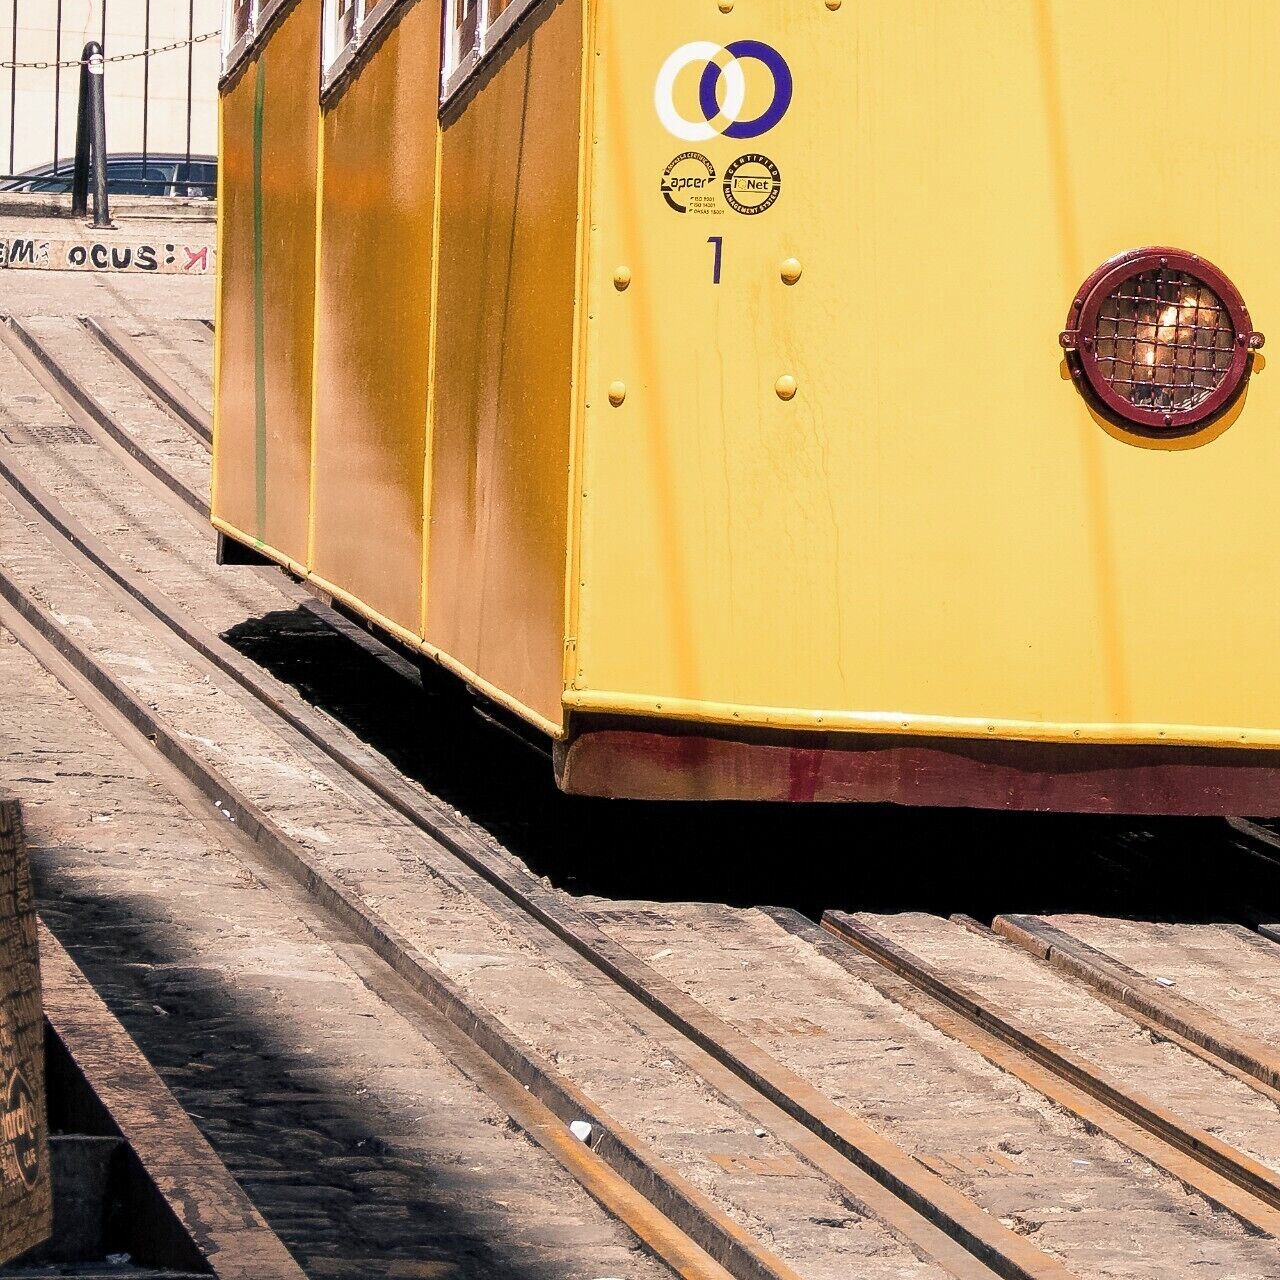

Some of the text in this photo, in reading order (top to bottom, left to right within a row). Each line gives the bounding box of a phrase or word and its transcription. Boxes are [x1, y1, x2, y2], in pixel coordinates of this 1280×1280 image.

[728, 155, 778, 176] CERTIFIED
[670, 177, 707, 192] apcer
[707, 236, 723, 284] 1
